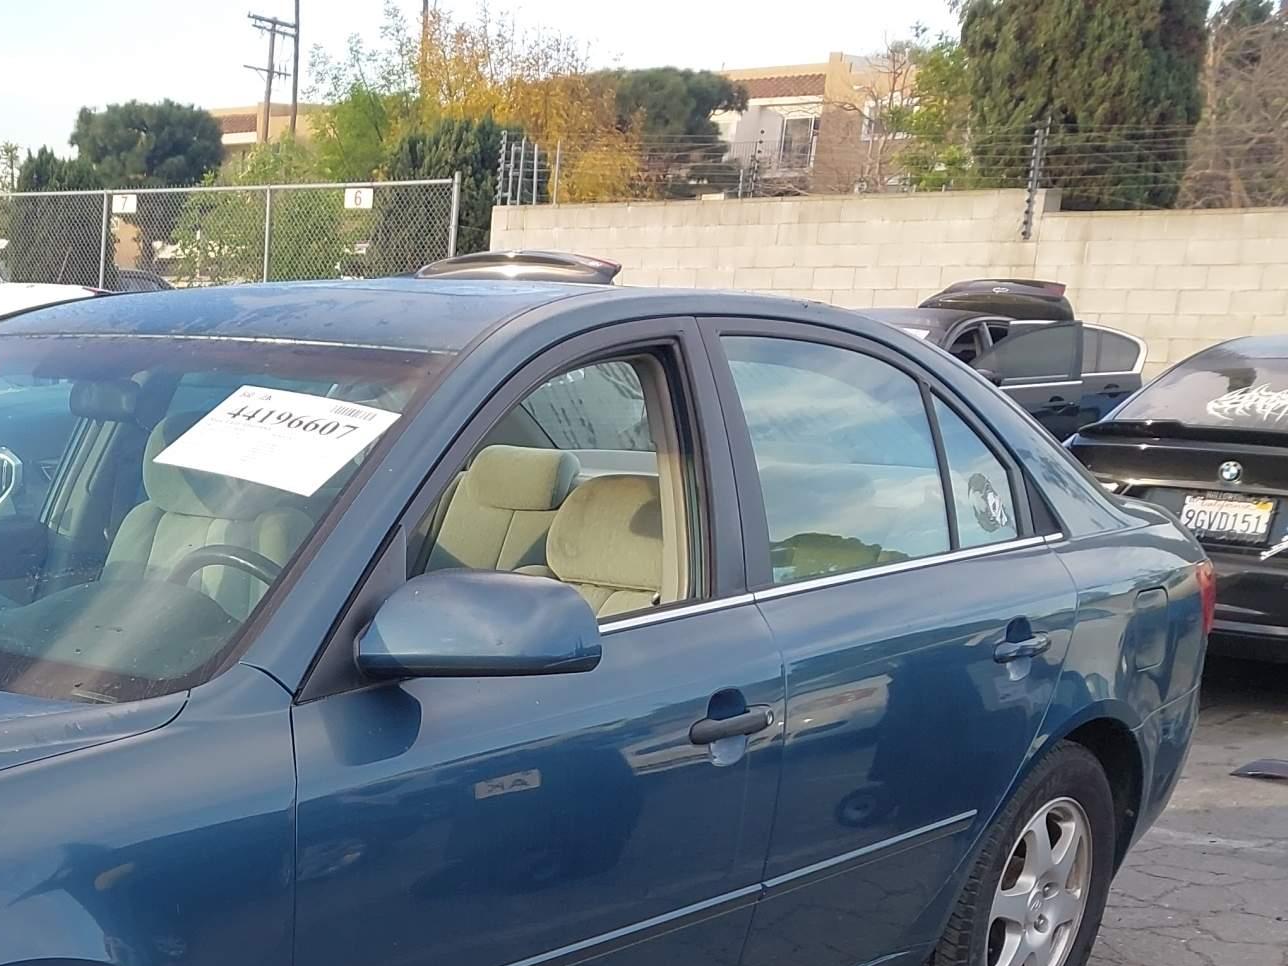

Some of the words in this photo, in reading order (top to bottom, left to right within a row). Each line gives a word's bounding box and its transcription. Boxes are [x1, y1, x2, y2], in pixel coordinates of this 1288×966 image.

[121, 196, 128, 211] 7
[354, 190, 362, 206] 6
[227, 404, 360, 439] 44196607
[1184, 508, 1263, 535] 9GVD151
